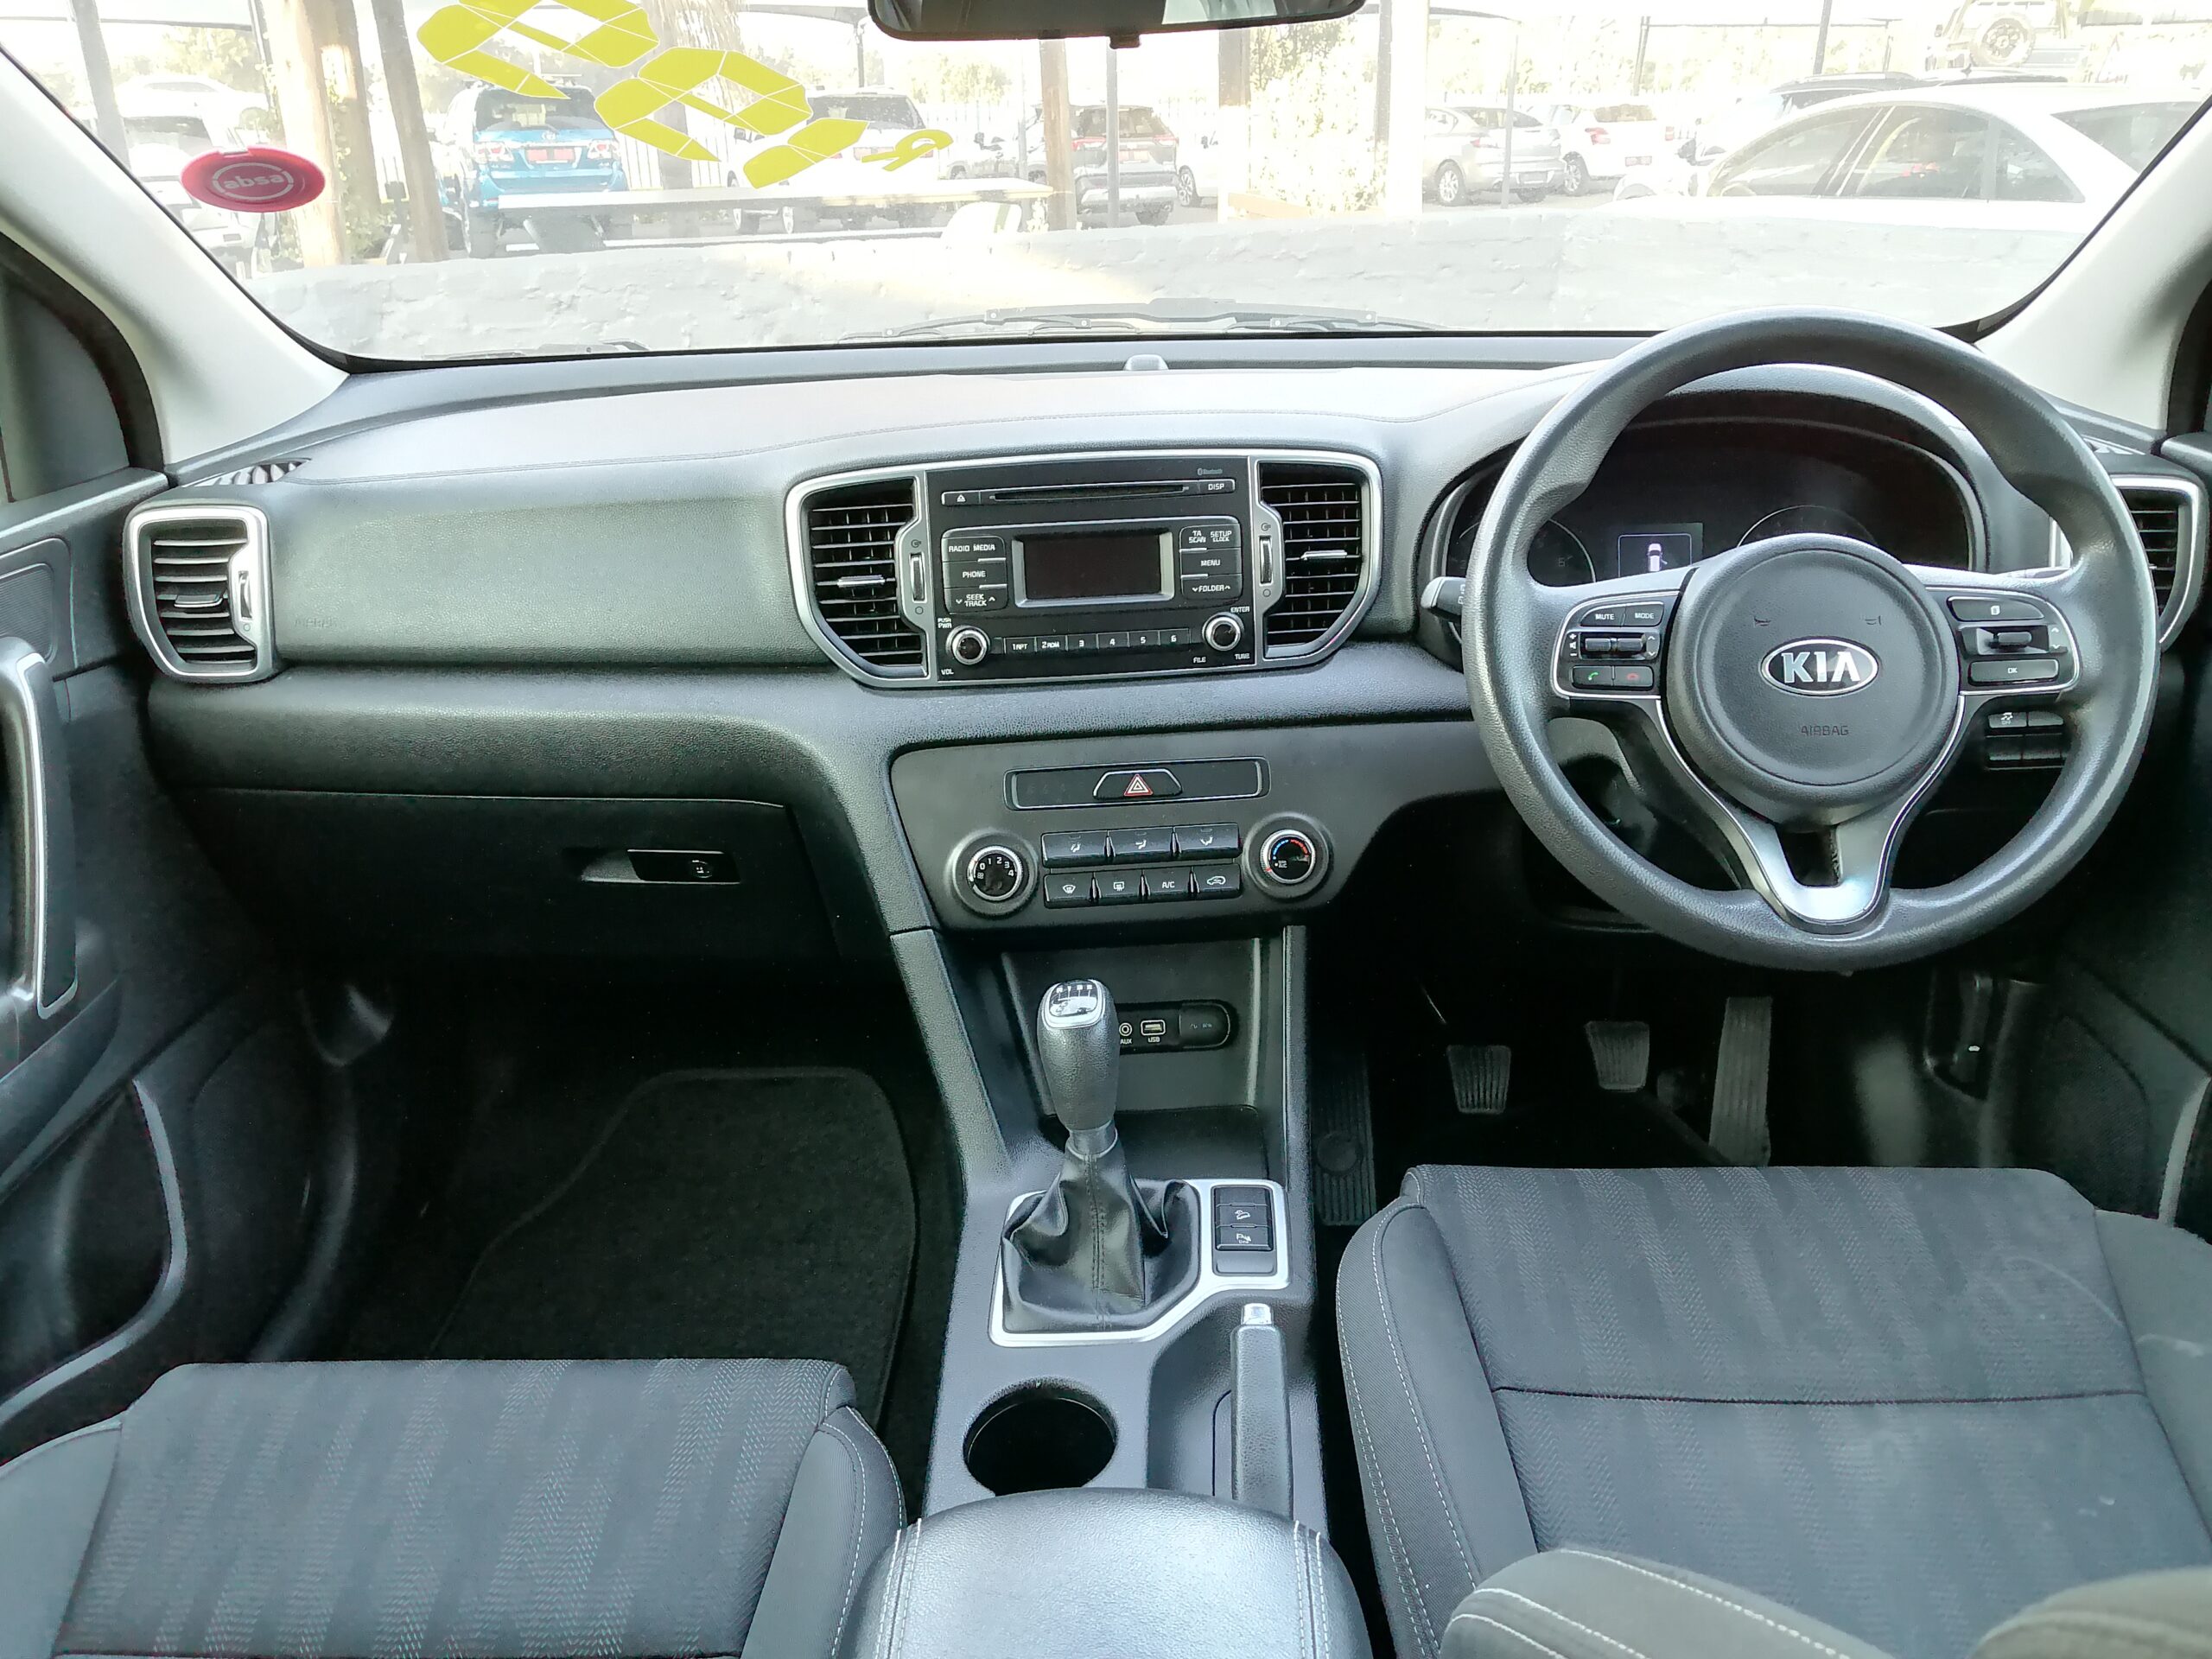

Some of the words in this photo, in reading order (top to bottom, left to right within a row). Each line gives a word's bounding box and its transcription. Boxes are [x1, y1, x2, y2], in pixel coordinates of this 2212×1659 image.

[224, 175, 284, 189] absa
[1781, 652, 1860, 683] KIA
[1801, 725, 1849, 736] AIRBAG
